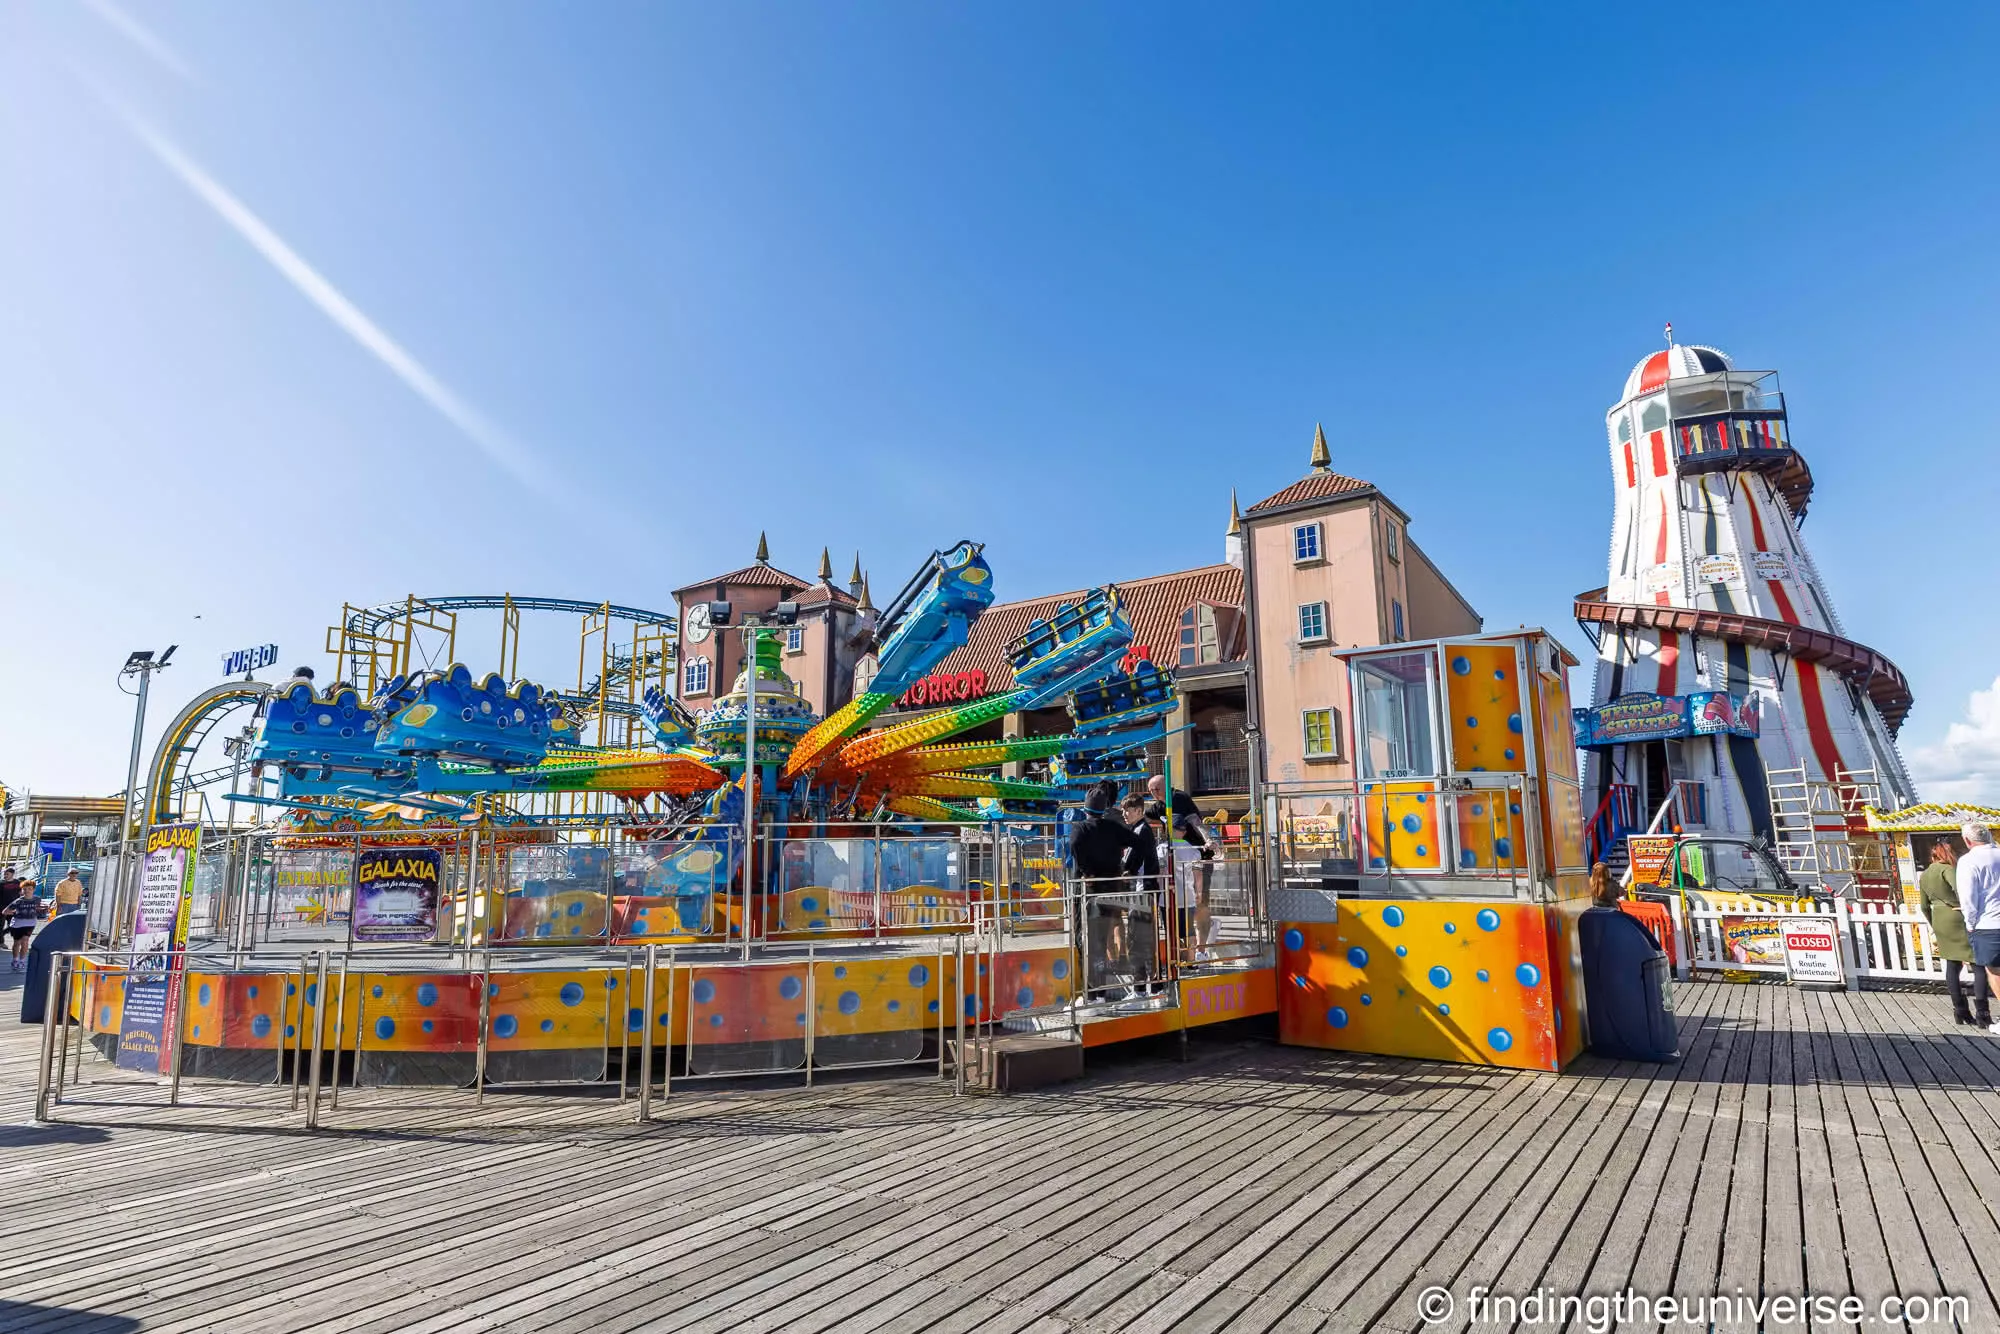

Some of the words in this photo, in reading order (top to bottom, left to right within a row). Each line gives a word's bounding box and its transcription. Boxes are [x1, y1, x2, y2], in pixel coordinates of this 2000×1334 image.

[1599, 700, 1662, 724] HELTER
[1605, 713, 1681, 738] SKELTER
[403, 737, 416, 748] 01
[1385, 770, 1408, 778] £5.00
[147, 826, 197, 853] GALAXIA
[1023, 857, 1063, 869] ENTRANCE
[359, 858, 436, 883] GALAXIA
[277, 870, 349, 887] ENTRANCE
[1796, 925, 1817, 933] Sorry
[1788, 937, 1831, 949] CLOSED
[1805, 952, 1817, 960] For
[1798, 960, 1827, 968] Routine
[1791, 968, 1838, 977] Maintenance
[1187, 982, 1248, 1017] ENTRY
